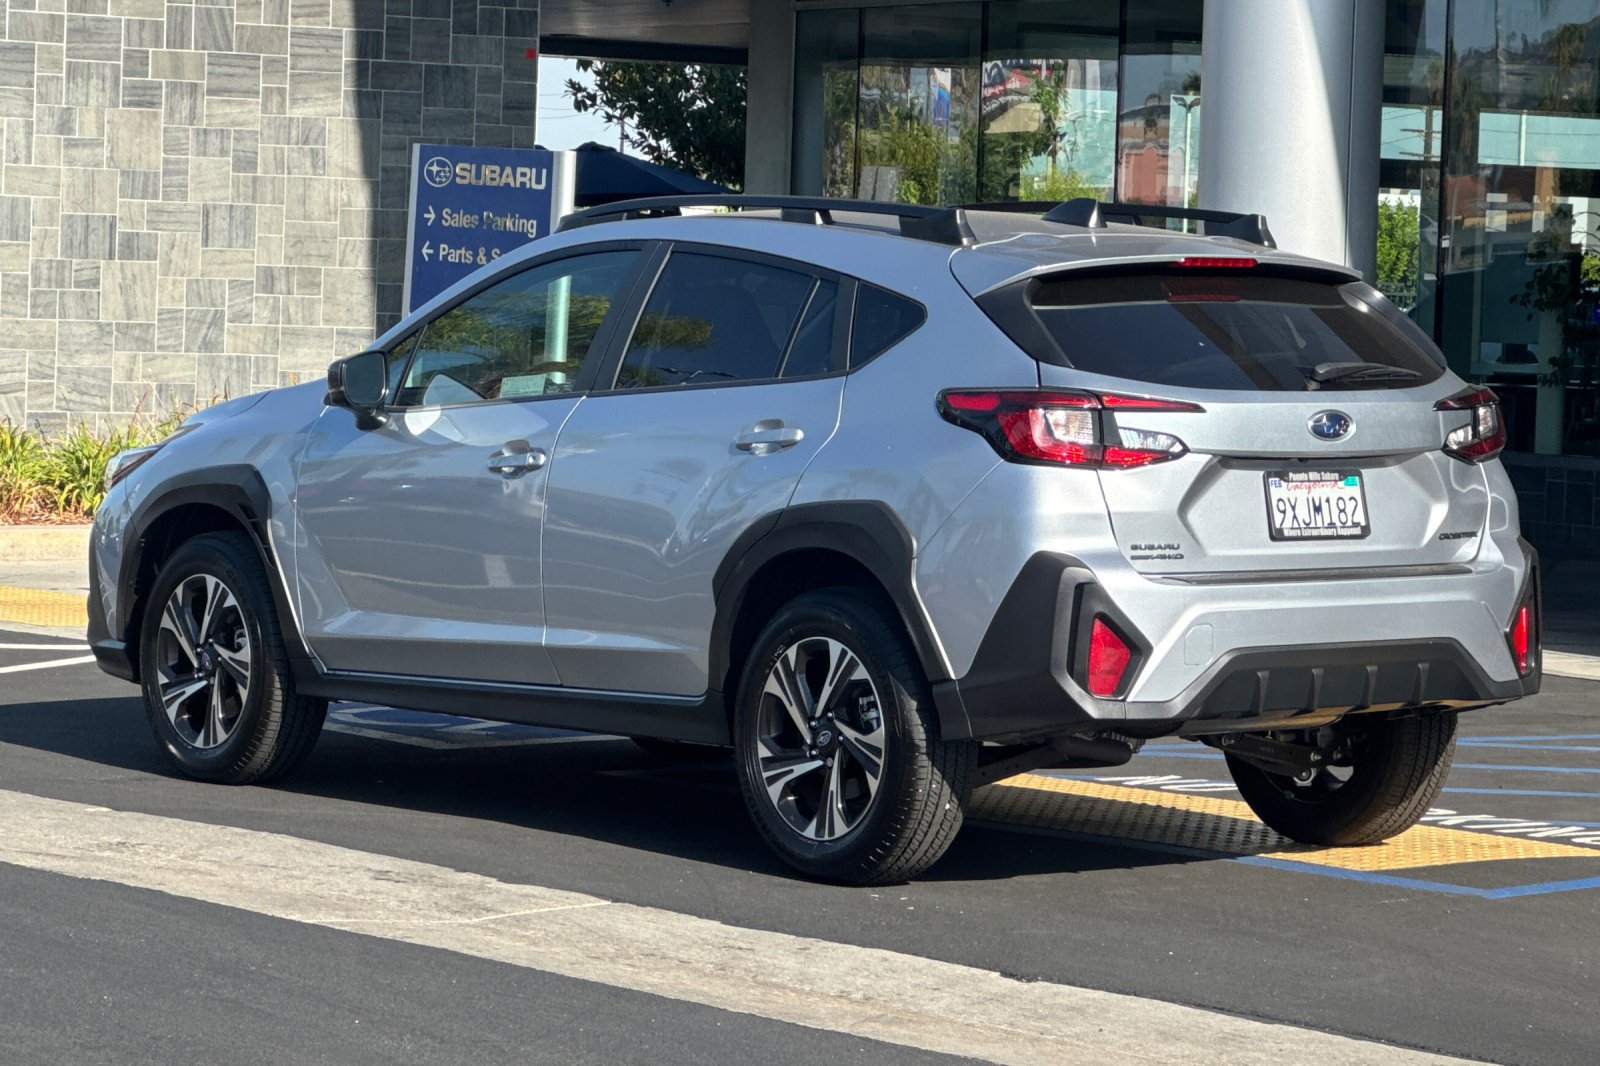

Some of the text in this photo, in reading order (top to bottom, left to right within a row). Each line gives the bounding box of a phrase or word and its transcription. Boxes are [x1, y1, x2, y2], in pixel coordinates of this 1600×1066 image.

[455, 162, 547, 190] SUBARU
[441, 208, 537, 238] Sales Parking
[439, 244, 473, 264] Parts
[477, 247, 487, 265] &
[1276, 496, 1360, 527] 9XJM182
